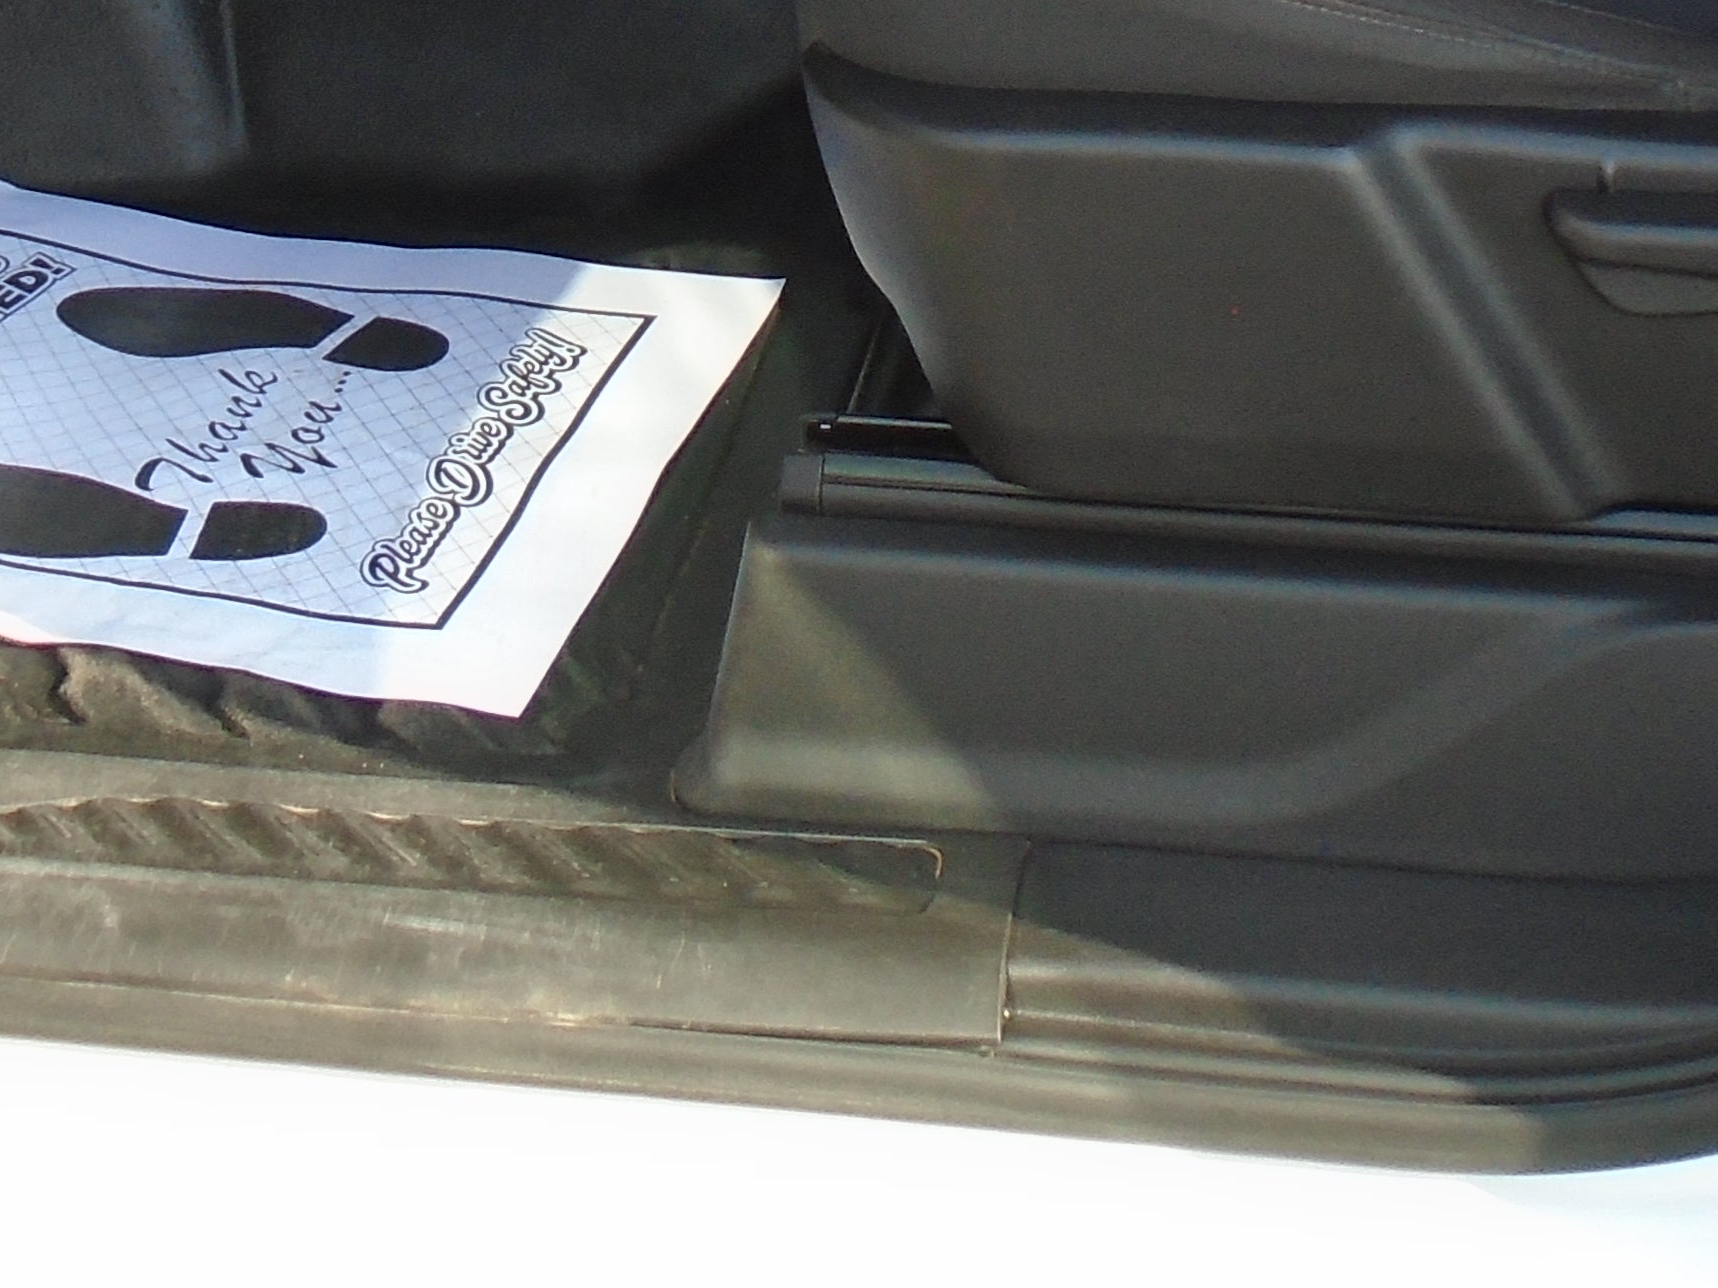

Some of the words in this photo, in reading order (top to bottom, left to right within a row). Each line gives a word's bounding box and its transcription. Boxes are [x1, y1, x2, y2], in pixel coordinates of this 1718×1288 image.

[134, 368, 278, 492] Thank
[360, 496, 459, 593] Please
[427, 417, 513, 506] Drive
[477, 328, 587, 426] Safely!
